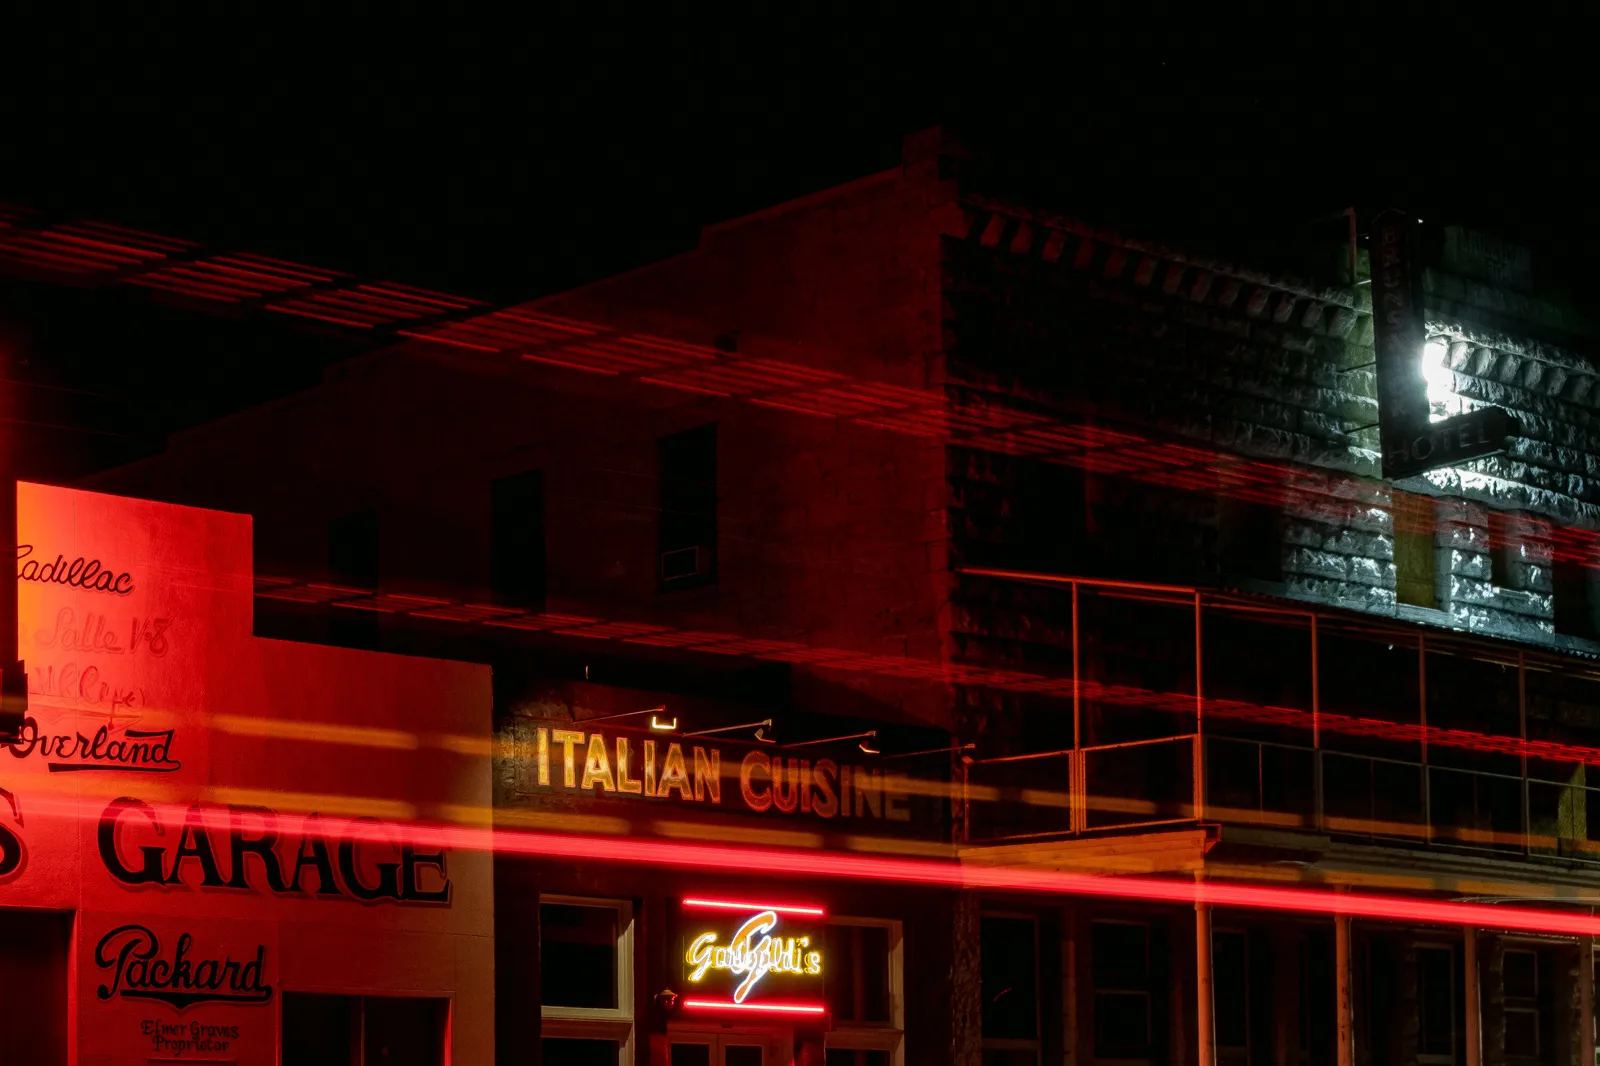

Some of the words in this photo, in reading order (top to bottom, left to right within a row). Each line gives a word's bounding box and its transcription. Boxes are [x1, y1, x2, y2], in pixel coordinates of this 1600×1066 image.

[1387, 421, 1493, 466] HOTEL
[3, 717, 181, 769] Overland
[536, 727, 722, 804] ITALIAN
[739, 750, 911, 822] CUISINE
[97, 796, 453, 906] GARAGE
[95, 924, 272, 1003] Packard
[141, 1019, 187, 1036] Elmer
[190, 1020, 240, 1039] Graves
[151, 1035, 231, 1056] Proprietor
